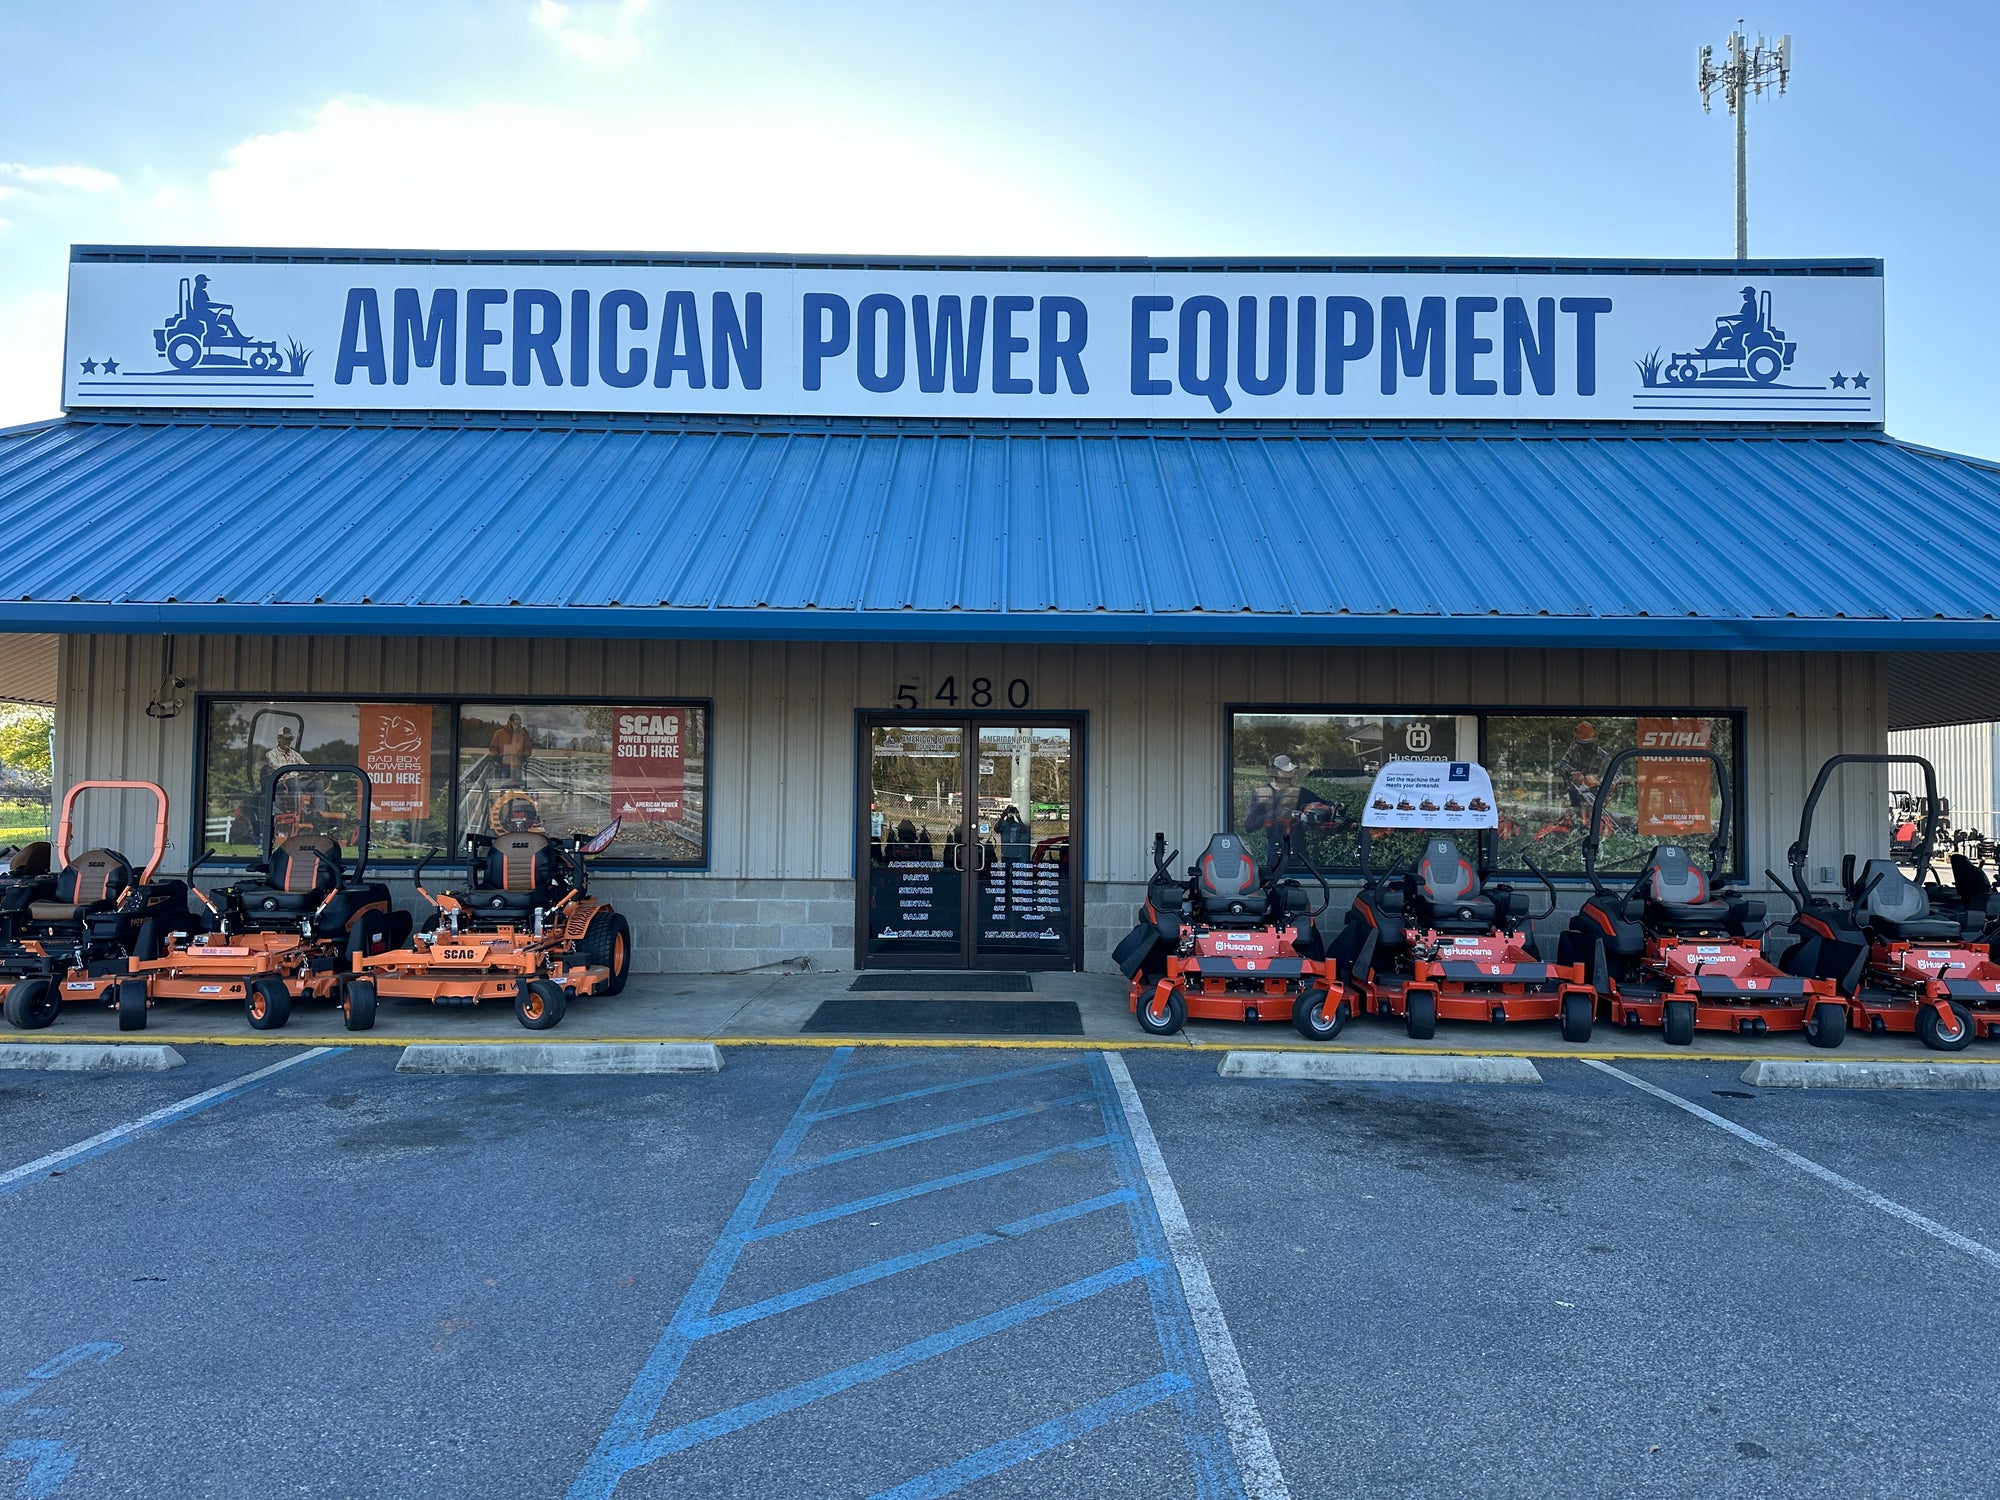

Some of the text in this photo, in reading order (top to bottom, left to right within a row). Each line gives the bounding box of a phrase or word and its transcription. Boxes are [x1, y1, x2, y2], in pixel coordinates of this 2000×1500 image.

[334, 287, 1613, 414] AMERICAN POWER EQUIPMENT
[895, 675, 1030, 709] 5480
[619, 715, 679, 735] SCAG
[619, 735, 679, 744] POWER EQUIPMENT
[901, 735, 961, 743] AMERICAN POWER
[983, 735, 1041, 744] AMERICAN POWER
[1642, 731, 1706, 746] STIHL
[617, 745, 680, 758] SOLD HERE
[367, 755, 421, 763] BAD BOY
[368, 772, 421, 784] SOLD HERE
[1224, 942, 1263, 951] Husqvarna
[444, 949, 474, 959] SCAG
[1452, 947, 1492, 956] Husqvarna
[229, 985, 242, 993] 48
[496, 983, 506, 991] 61
